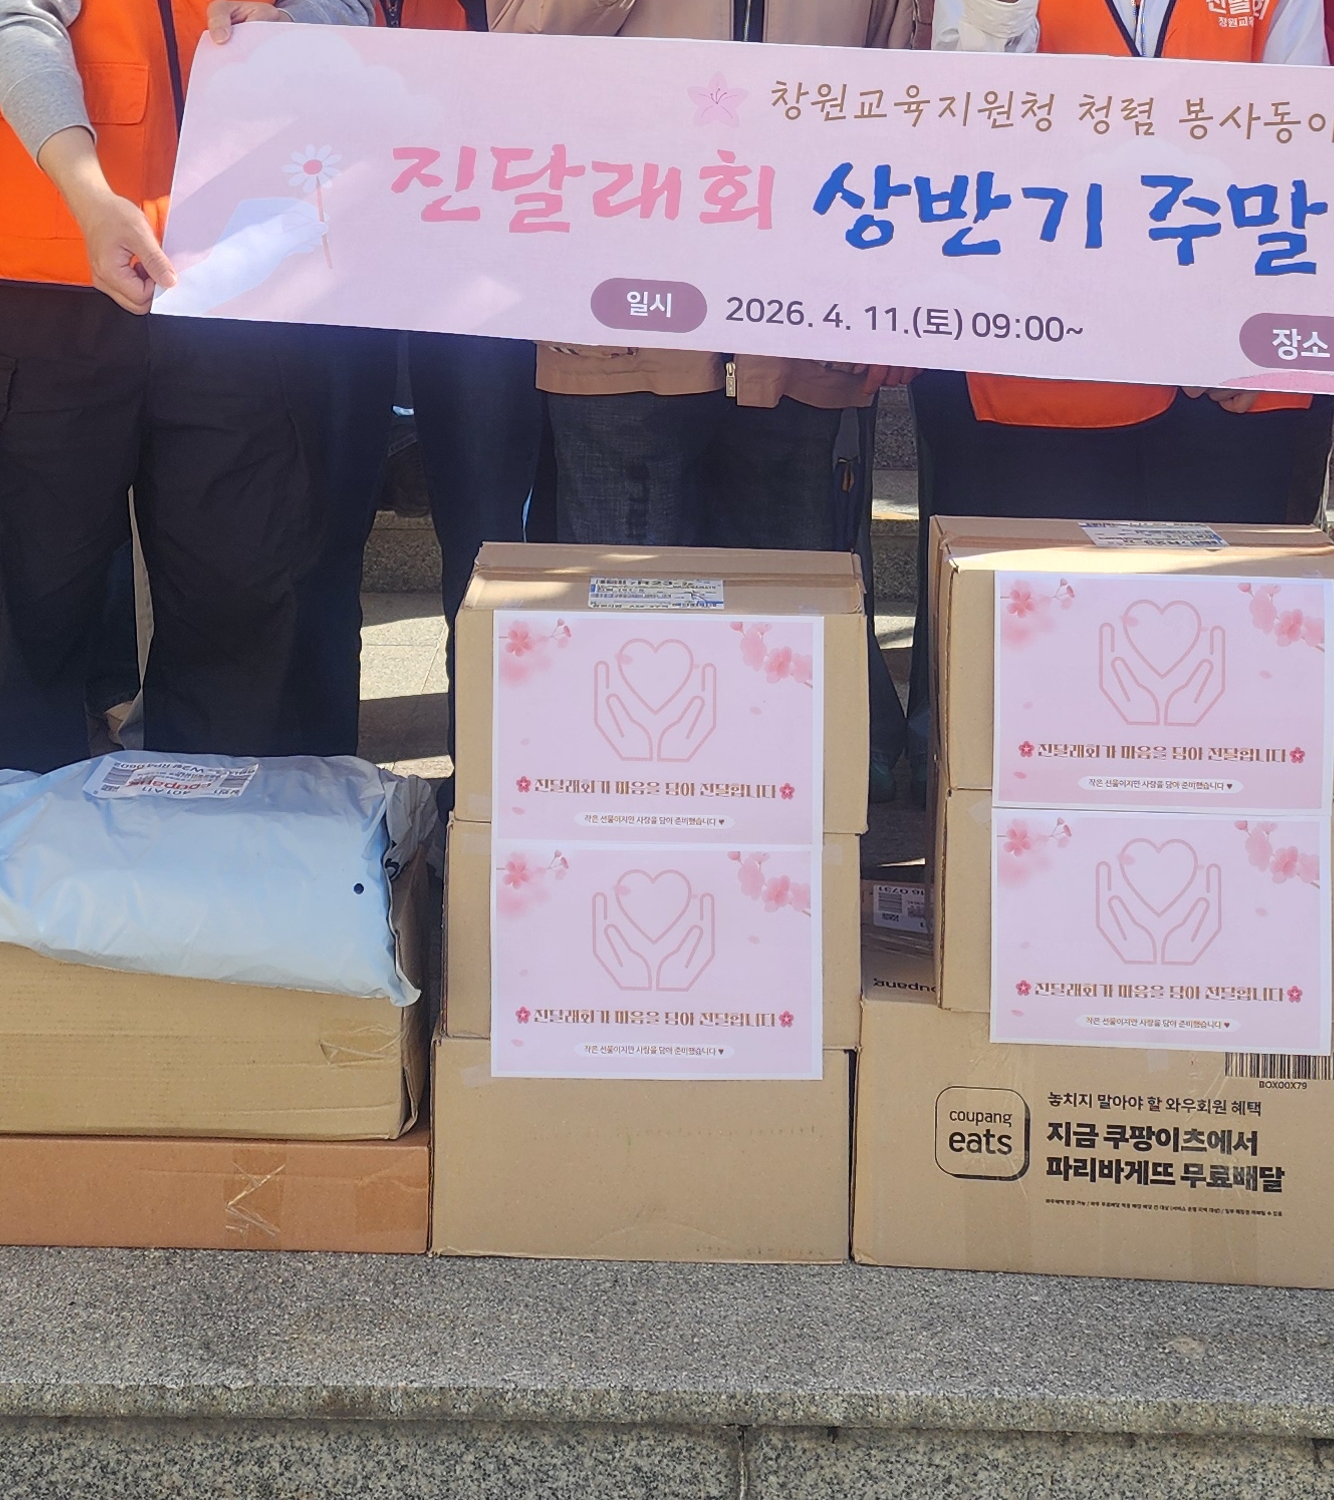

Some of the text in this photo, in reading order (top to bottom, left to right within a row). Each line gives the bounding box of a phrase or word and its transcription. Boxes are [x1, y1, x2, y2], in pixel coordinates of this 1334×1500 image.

[771, 80, 1055, 133] 창원교육지원청
[1077, 93, 1155, 138] 청렴
[390, 143, 775, 235] 진달래회
[812, 161, 1104, 257] 상반기
[1140, 174, 1327, 277] 주말
[625, 289, 673, 318] 일시
[725, 296, 813, 329] 2026.
[822, 303, 853, 331] 4.
[1271, 327, 1331, 362] 장소
[1038, 743, 1286, 763] 진달래회가 마음을 담아 전달합니다
[534, 778, 776, 799] 진달래회가 마음을 담아 전달합니다
[873, 978, 936, 992] upang
[1034, 982, 1283, 1002] 진달래회가 마음을 담아 전달합니다
[534, 1009, 775, 1028] 진달래회가 마음을 담아 전달합니다
[1047, 1091, 1263, 1117] 놓치지 말아야 할 와우회원 혜택
[949, 1109, 1013, 1128] coupang
[948, 1128, 1013, 1155] eats
[1046, 1121, 1259, 1158] 지금 쿠팡이츠에서
[1045, 1155, 1285, 1194] 파리바게뜨 무료배달
